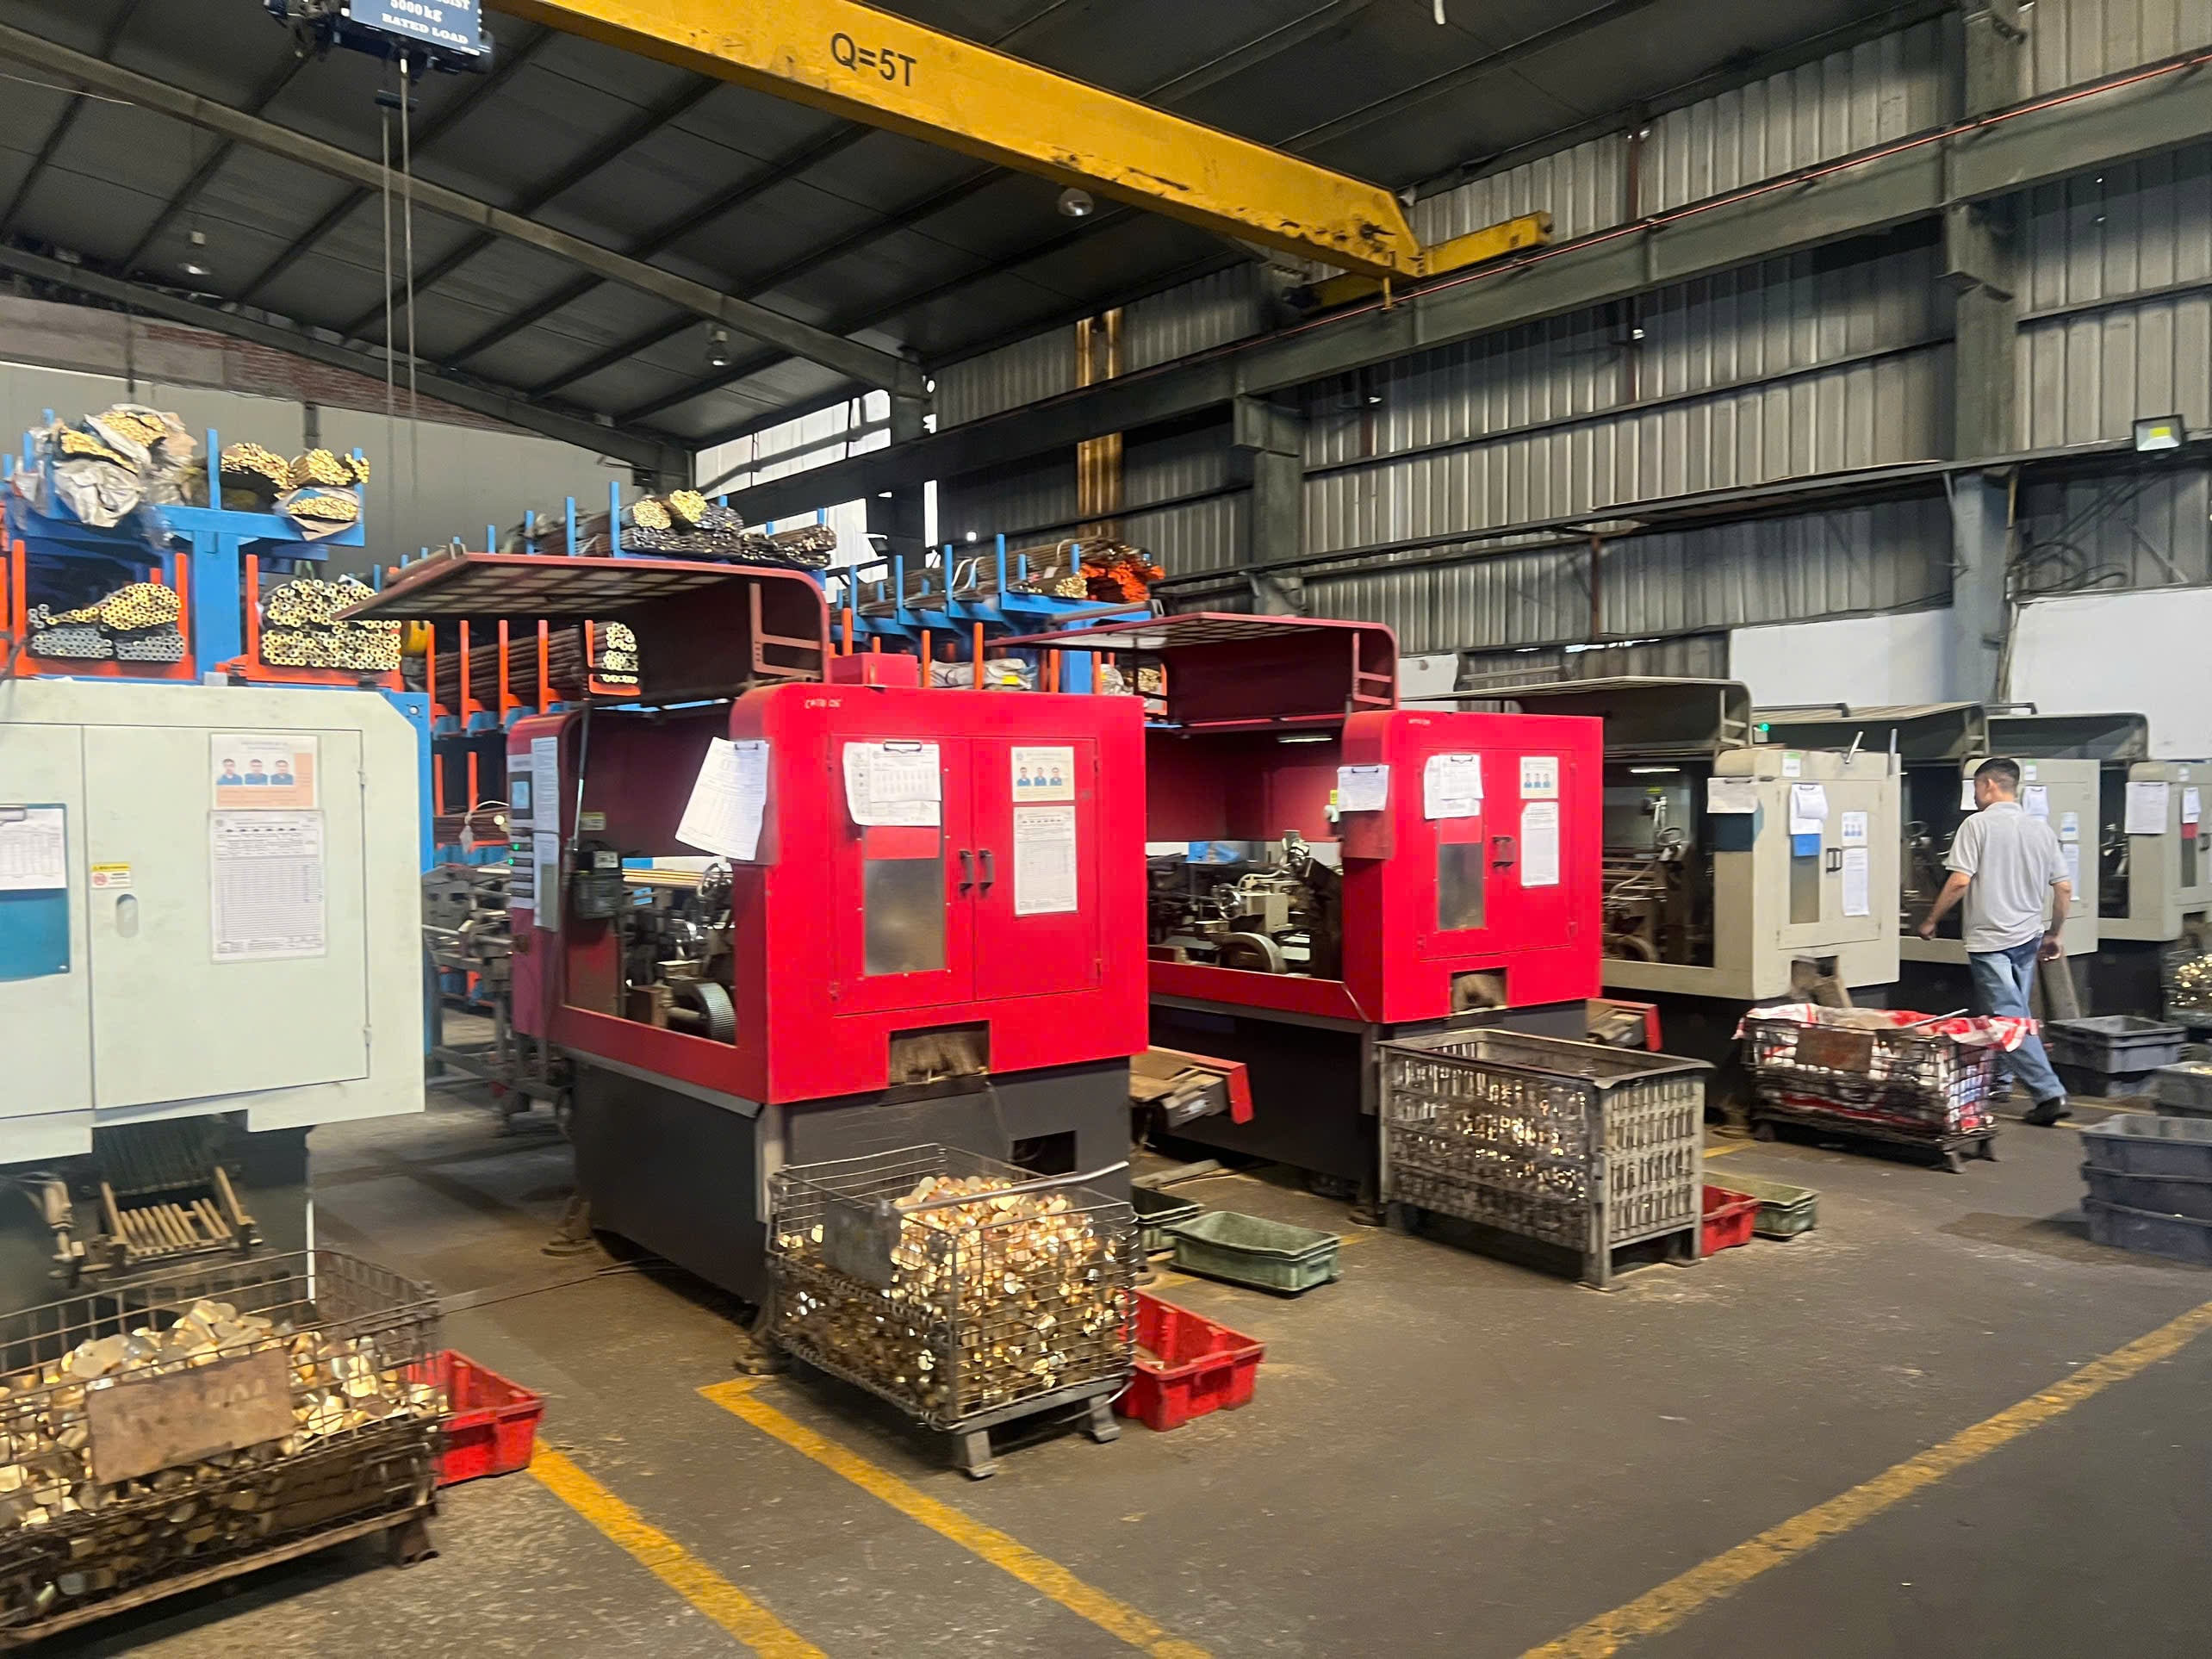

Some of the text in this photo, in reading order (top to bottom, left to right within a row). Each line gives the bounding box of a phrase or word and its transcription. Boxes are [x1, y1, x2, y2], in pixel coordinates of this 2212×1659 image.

[382, 13, 469, 44] RATED LOAD
[830, 32, 916, 87] Q=5T
